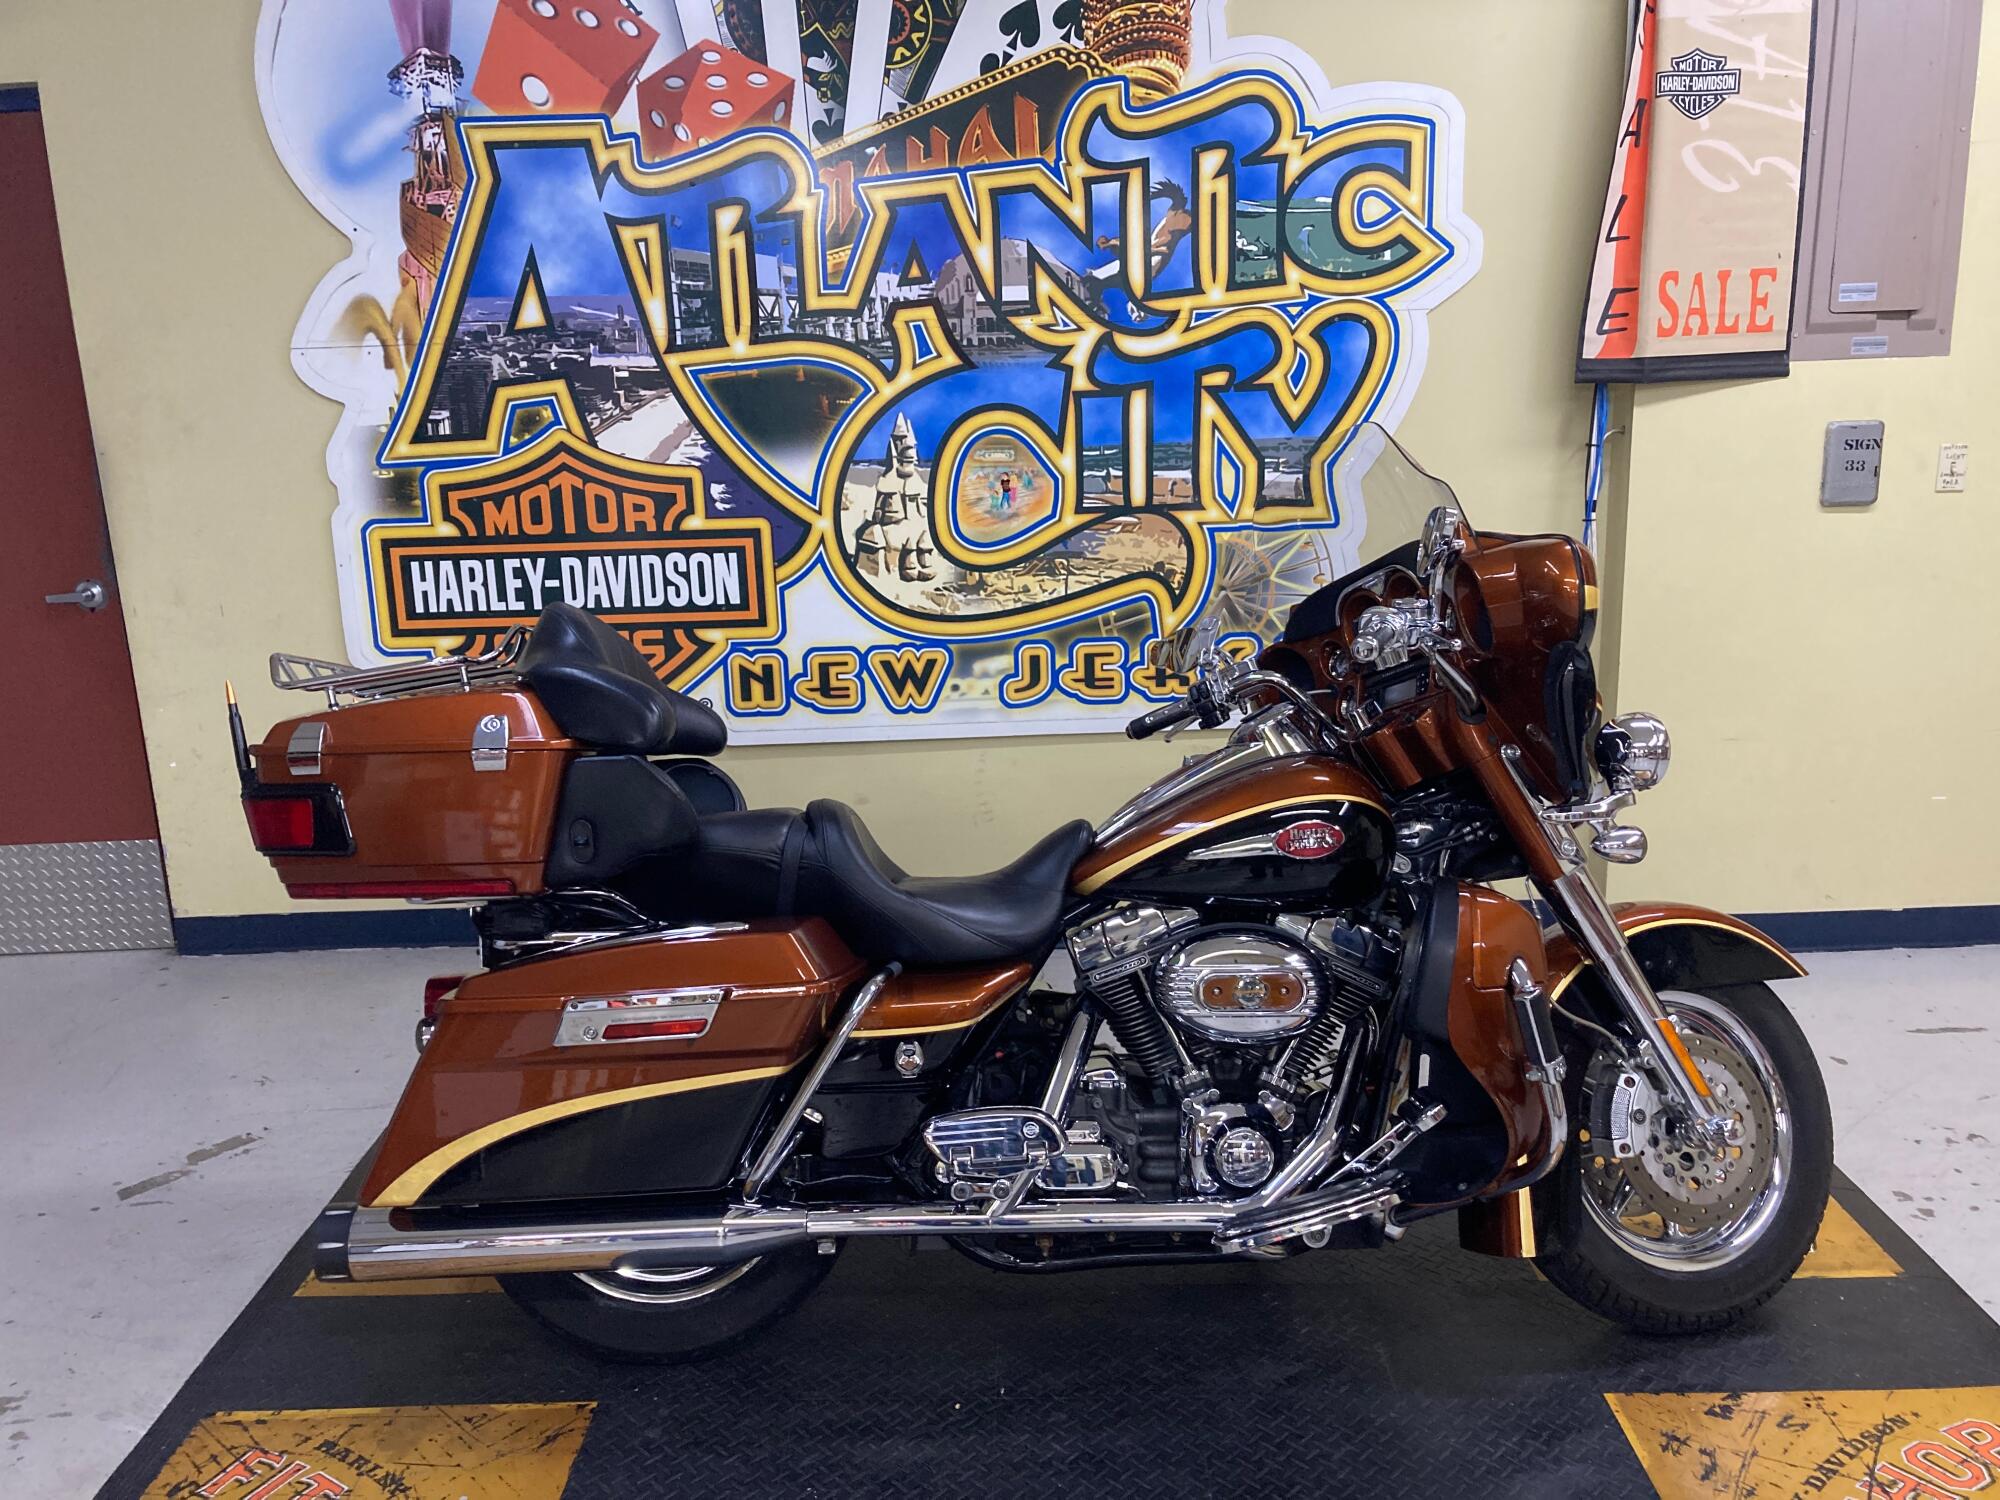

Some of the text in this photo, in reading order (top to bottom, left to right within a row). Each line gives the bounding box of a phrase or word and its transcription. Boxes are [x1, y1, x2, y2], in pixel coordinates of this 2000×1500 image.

[1660, 74, 1736, 92] HARLEY-DAVIDSON
[1679, 54, 1717, 71] MOTOR
[1678, 95, 1716, 114] CYCLES
[380, 76, 1452, 466] ATLANTIC
[1656, 267, 1779, 338] SALE
[812, 300, 1398, 638] CITY
[1844, 438, 1883, 451] SIGN
[1844, 459, 1867, 472] 33
[482, 470, 657, 537] MOTOR
[409, 551, 741, 614] HARLEY-DAVIDSON
[732, 648, 945, 709] NEW
[1289, 827, 1331, 841] HARLEY
[1801, 1413, 1911, 1493] DAVIDSON
